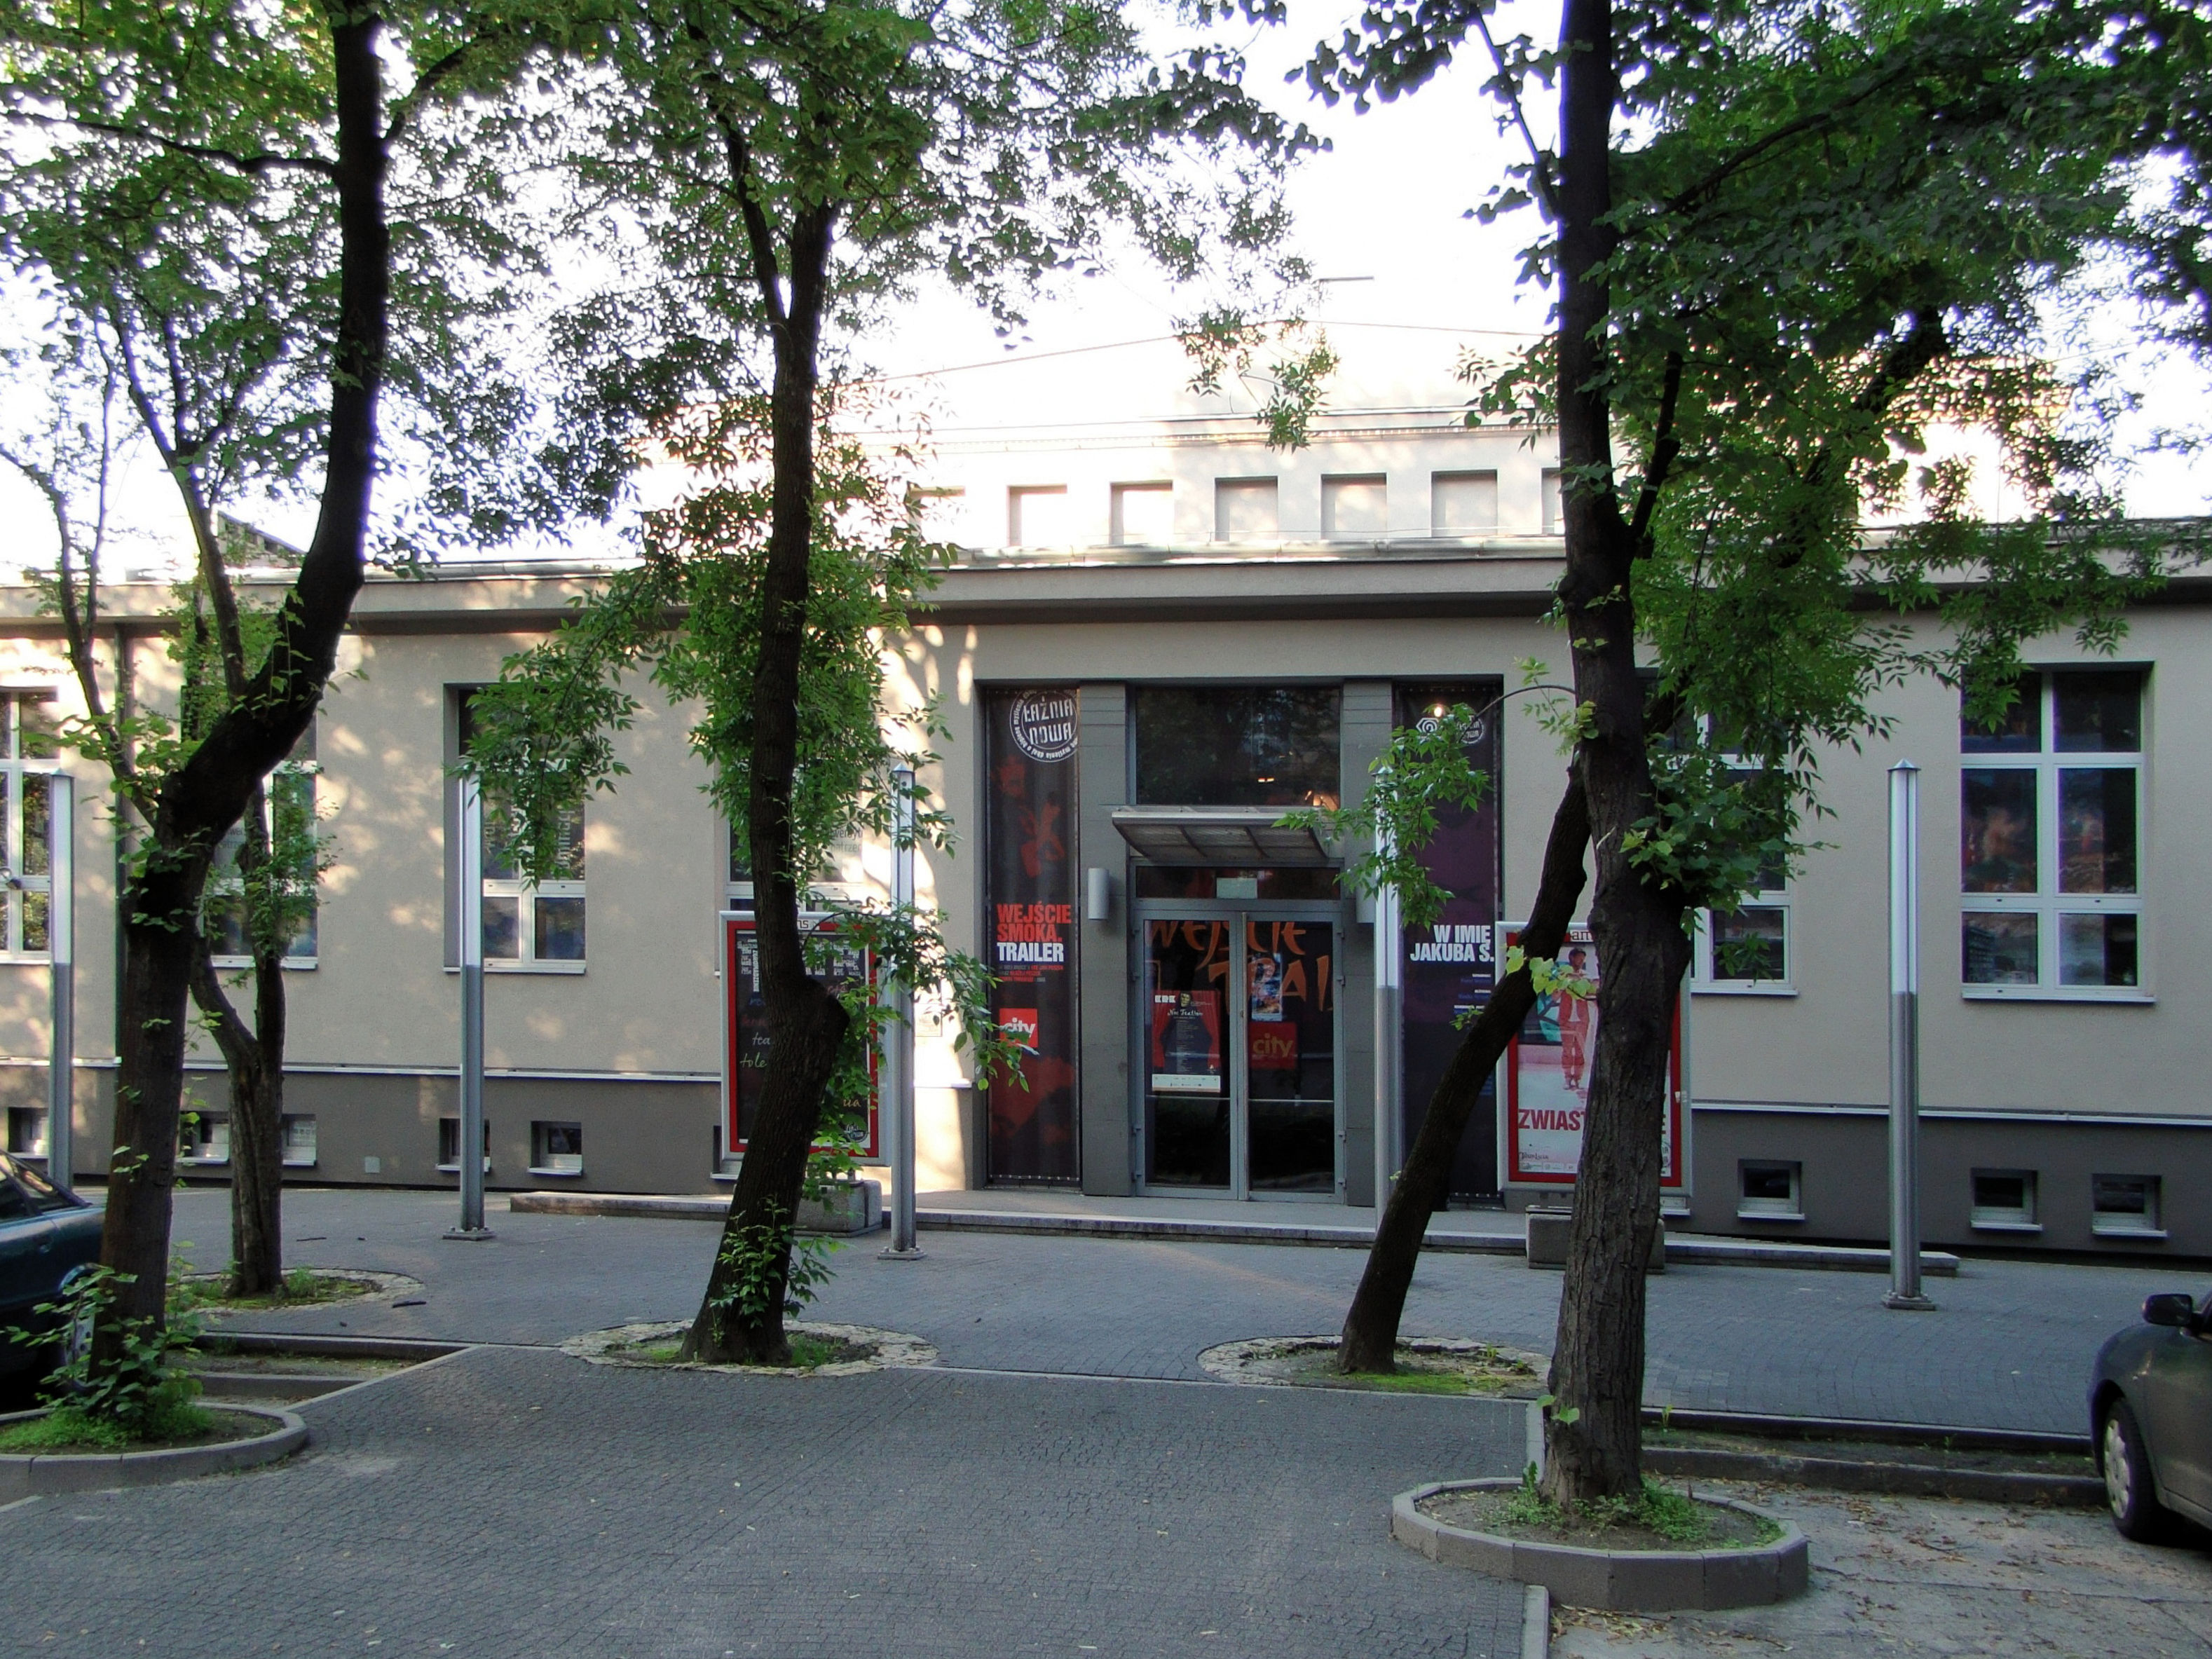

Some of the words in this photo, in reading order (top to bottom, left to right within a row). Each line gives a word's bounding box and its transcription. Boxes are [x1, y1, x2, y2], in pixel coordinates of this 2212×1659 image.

[996, 900, 1072, 924] WEJŚCIE
[996, 923, 1063, 943] SMOKA.
[1433, 924, 1452, 943] W
[996, 941, 1065, 962] TRAILER
[1409, 943, 1475, 962] JAKUBA
[1252, 1032, 1293, 1059] city
